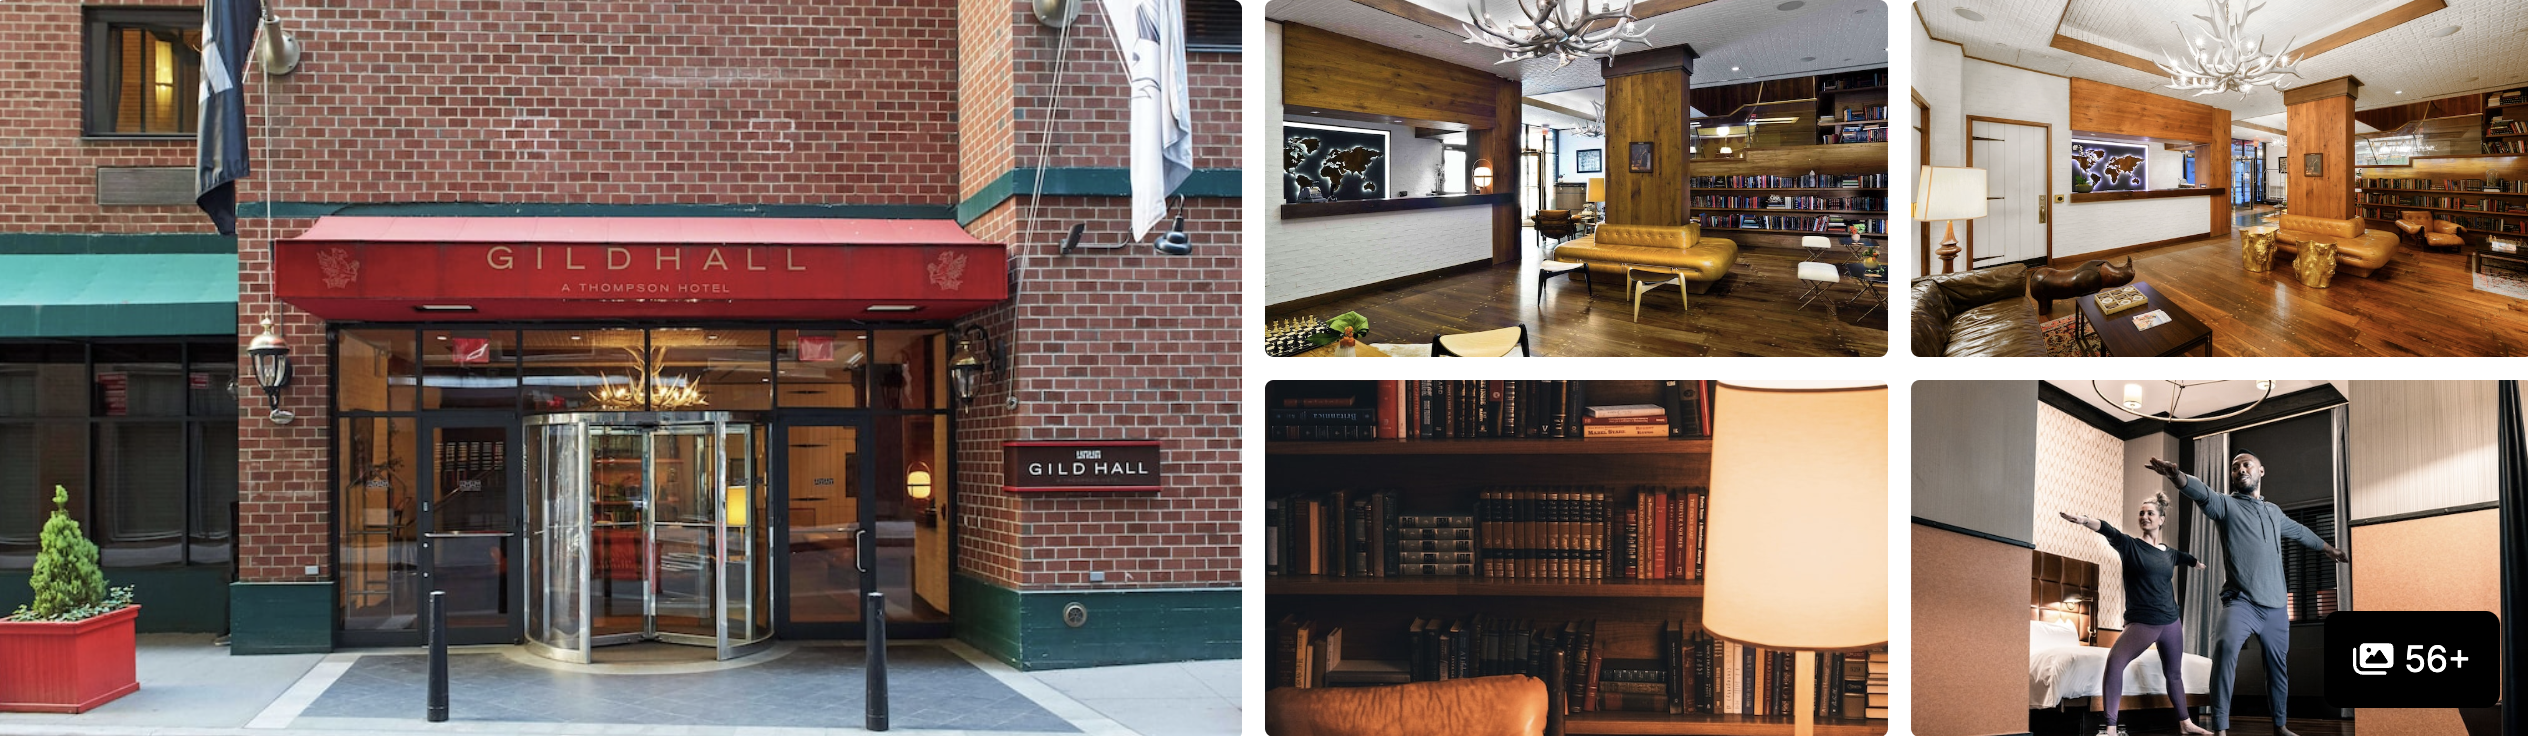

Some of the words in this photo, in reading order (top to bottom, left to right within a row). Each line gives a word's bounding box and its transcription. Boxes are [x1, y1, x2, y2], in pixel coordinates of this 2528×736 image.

[561, 283, 571, 292] A
[578, 283, 671, 293] THOMPSON
[678, 283, 730, 293] HOTEL
[1028, 462, 1086, 476] GILD
[1094, 461, 1149, 475] HALL
